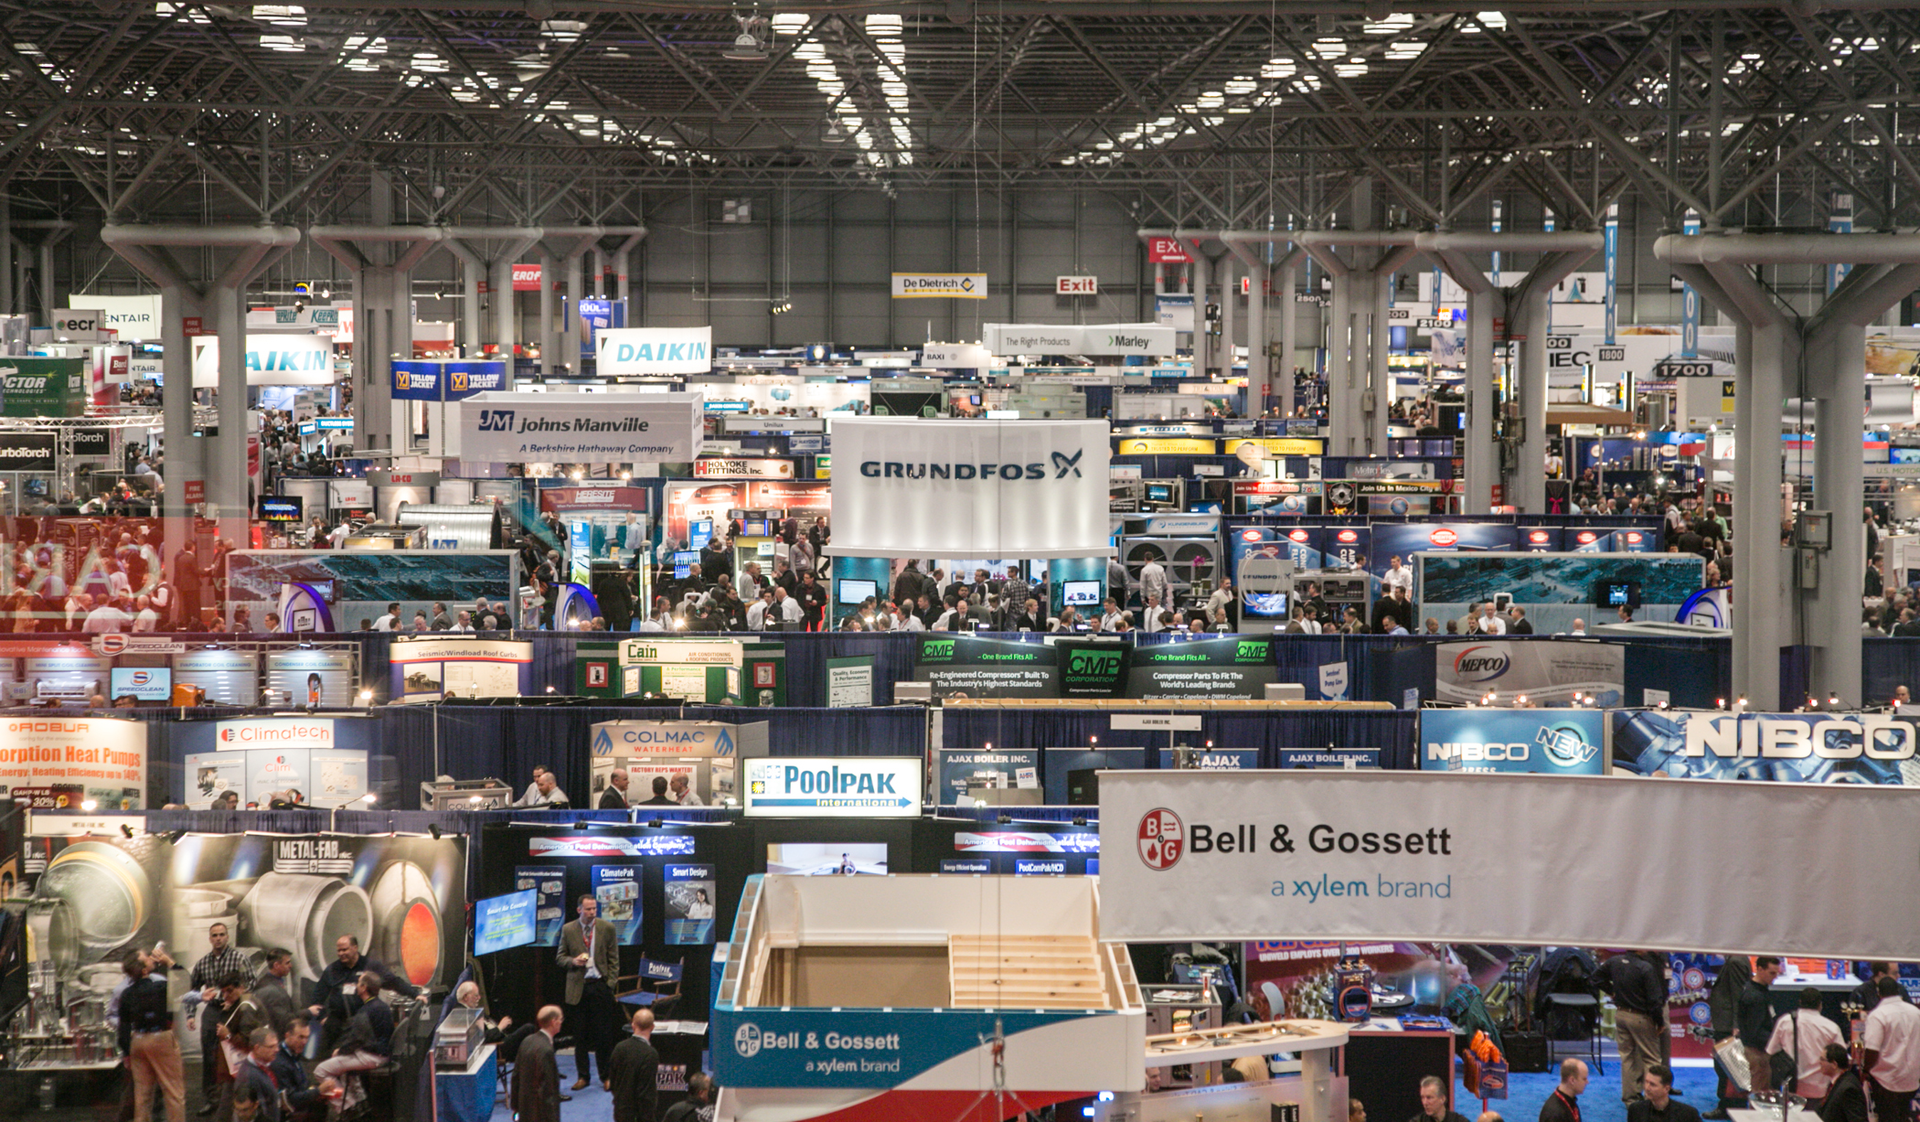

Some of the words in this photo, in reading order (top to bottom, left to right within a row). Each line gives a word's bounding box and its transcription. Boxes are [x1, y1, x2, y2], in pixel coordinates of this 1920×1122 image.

[1156, 241, 1182, 253] EXI
[903, 279, 917, 288] De
[921, 278, 958, 288] Dietrich
[1060, 278, 1094, 292] Exit
[104, 314, 150, 323] ENTAIR
[1420, 320, 1451, 328] 2100
[67, 320, 95, 331] ecr
[1006, 337, 1018, 346] The
[1020, 337, 1037, 349] Right
[1039, 337, 1070, 347] Products
[1116, 335, 1149, 349] Marley
[617, 342, 706, 362] DAIKIN
[1600, 350, 1622, 360] 1800
[246, 350, 327, 371] AIKIN
[1550, 352, 1591, 368] IEC
[1661, 364, 1709, 376] 1700
[4, 377, 47, 388] CTOR
[410, 374, 436, 382] YELLOW
[469, 374, 499, 382] YELLOW
[518, 418, 570, 434] Johns
[574, 418, 648, 432] Manville
[520, 444, 526, 453] A
[530, 444, 574, 454] Berkshire
[577, 444, 626, 455] Hathaway
[628, 444, 674, 455] Company
[708, 468, 748, 476] FITTINGS,
[860, 461, 1046, 480] GRUNDFOS
[1418, 484, 1431, 492] City
[576, 490, 614, 499] HERESITE
[418, 649, 482, 658] Seismic/Windload
[628, 644, 657, 658] Cain
[924, 644, 954, 656] CMP
[1238, 645, 1267, 657] CMP
[1068, 656, 1123, 674] CMP
[1459, 658, 1503, 672] MEPCO
[930, 672, 976, 680] Re-Engineered
[1153, 672, 1192, 681] Compressor
[950, 680, 982, 689] Industry's
[983, 680, 1010, 689] Highest
[1186, 682, 1210, 690] Leading
[240, 725, 329, 741] Climatech
[624, 731, 705, 743] COLMAC
[1536, 726, 1598, 762] NEW
[1687, 719, 1915, 760] NIBCO
[66, 746, 100, 763] Heat
[103, 748, 140, 768] Pumps
[1428, 744, 1528, 760] NIBCO
[1202, 756, 1240, 766] AJAX
[32, 768, 64, 780] Heating
[67, 768, 103, 780] Efficiency
[105, 771, 115, 780] up
[785, 765, 895, 794] PoolPAK
[33, 797, 54, 806] 30%
[816, 799, 898, 807] International
[1190, 824, 1256, 853] Bell
[1270, 824, 1295, 853] &
[1308, 824, 1451, 855] Gossett
[280, 841, 338, 858] METAL-FAB
[601, 868, 634, 877] ClimatePak
[673, 868, 688, 877] Smart
[689, 868, 707, 878] Design
[1019, 863, 1063, 873] PoolComPak/HCD
[1271, 880, 1284, 896] a
[1293, 874, 1368, 903] xylem
[1378, 874, 1451, 898] brand
[1259, 951, 1289, 962] UNIWELD
[1290, 950, 1321, 960] EMPLOYS
[1323, 948, 1340, 958] OVER
[1361, 945, 1394, 956] WORKERS
[764, 1033, 798, 1049] Bell
[805, 1033, 819, 1049] &
[826, 1033, 899, 1050] Gossett
[806, 1062, 814, 1072] a
[817, 1059, 857, 1076] xylem
[861, 1059, 899, 1072] brand
